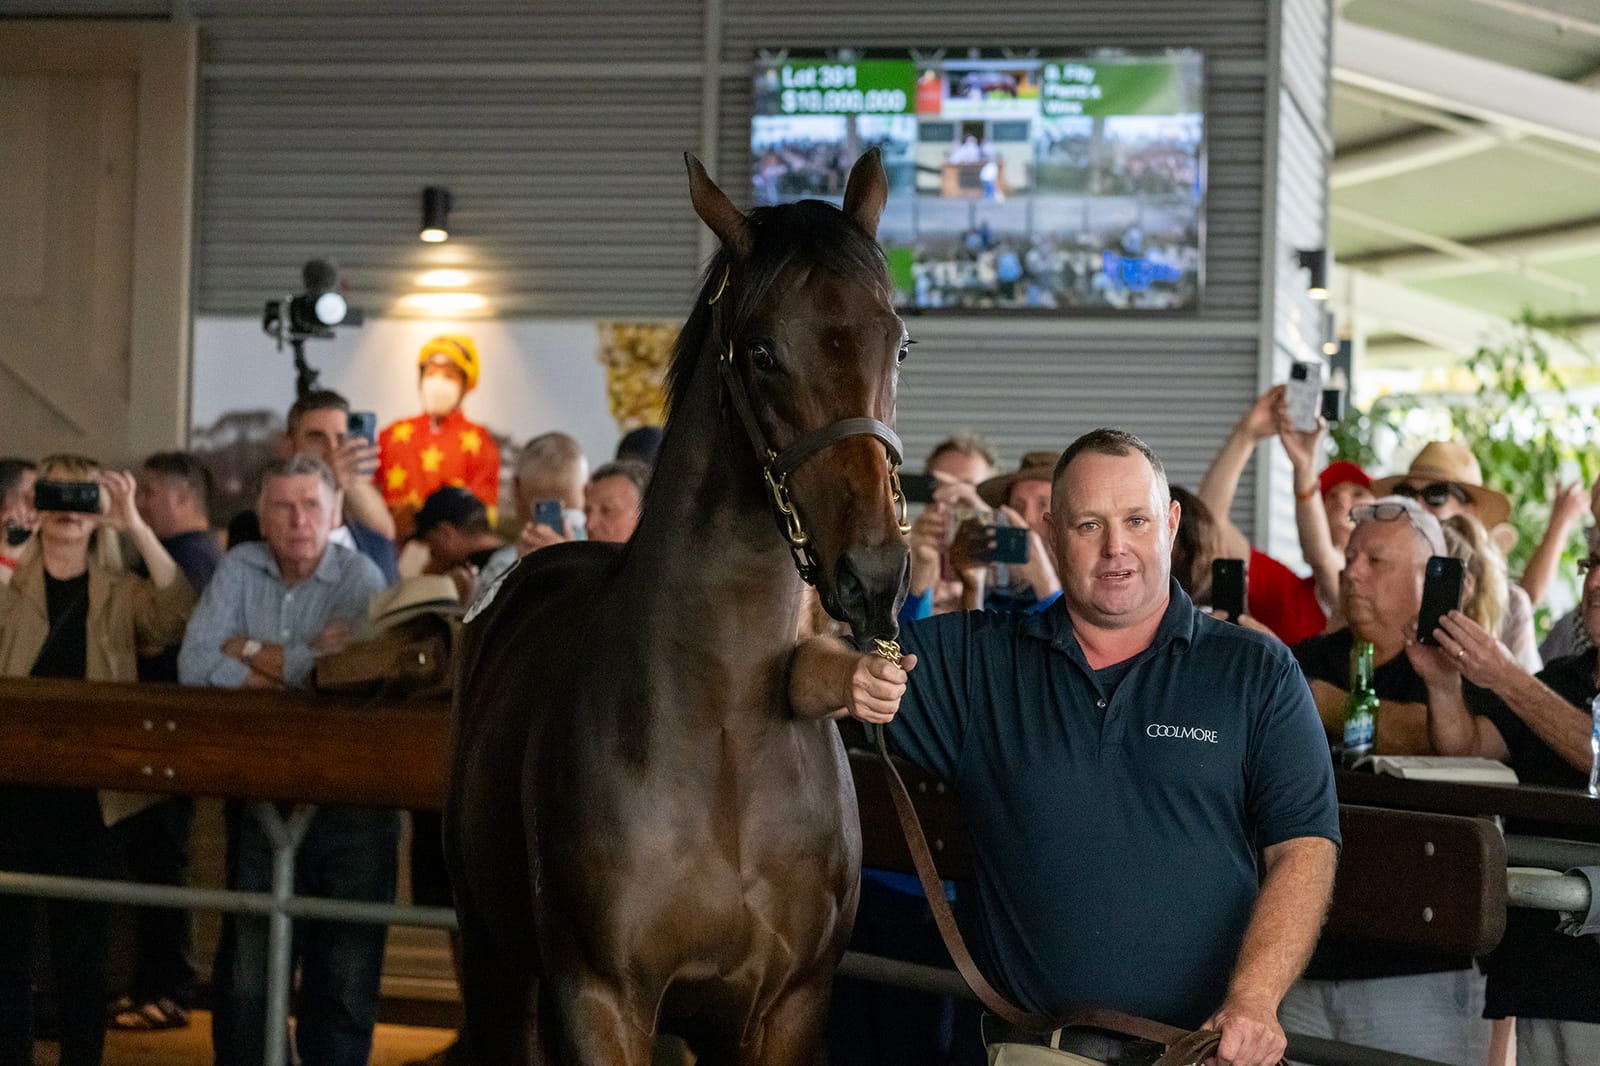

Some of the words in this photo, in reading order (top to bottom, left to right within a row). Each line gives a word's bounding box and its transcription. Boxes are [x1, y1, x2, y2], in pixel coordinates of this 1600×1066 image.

[782, 65, 817, 88] Lot
[818, 65, 857, 88] 391
[1146, 723, 1218, 743] COOLMORE
